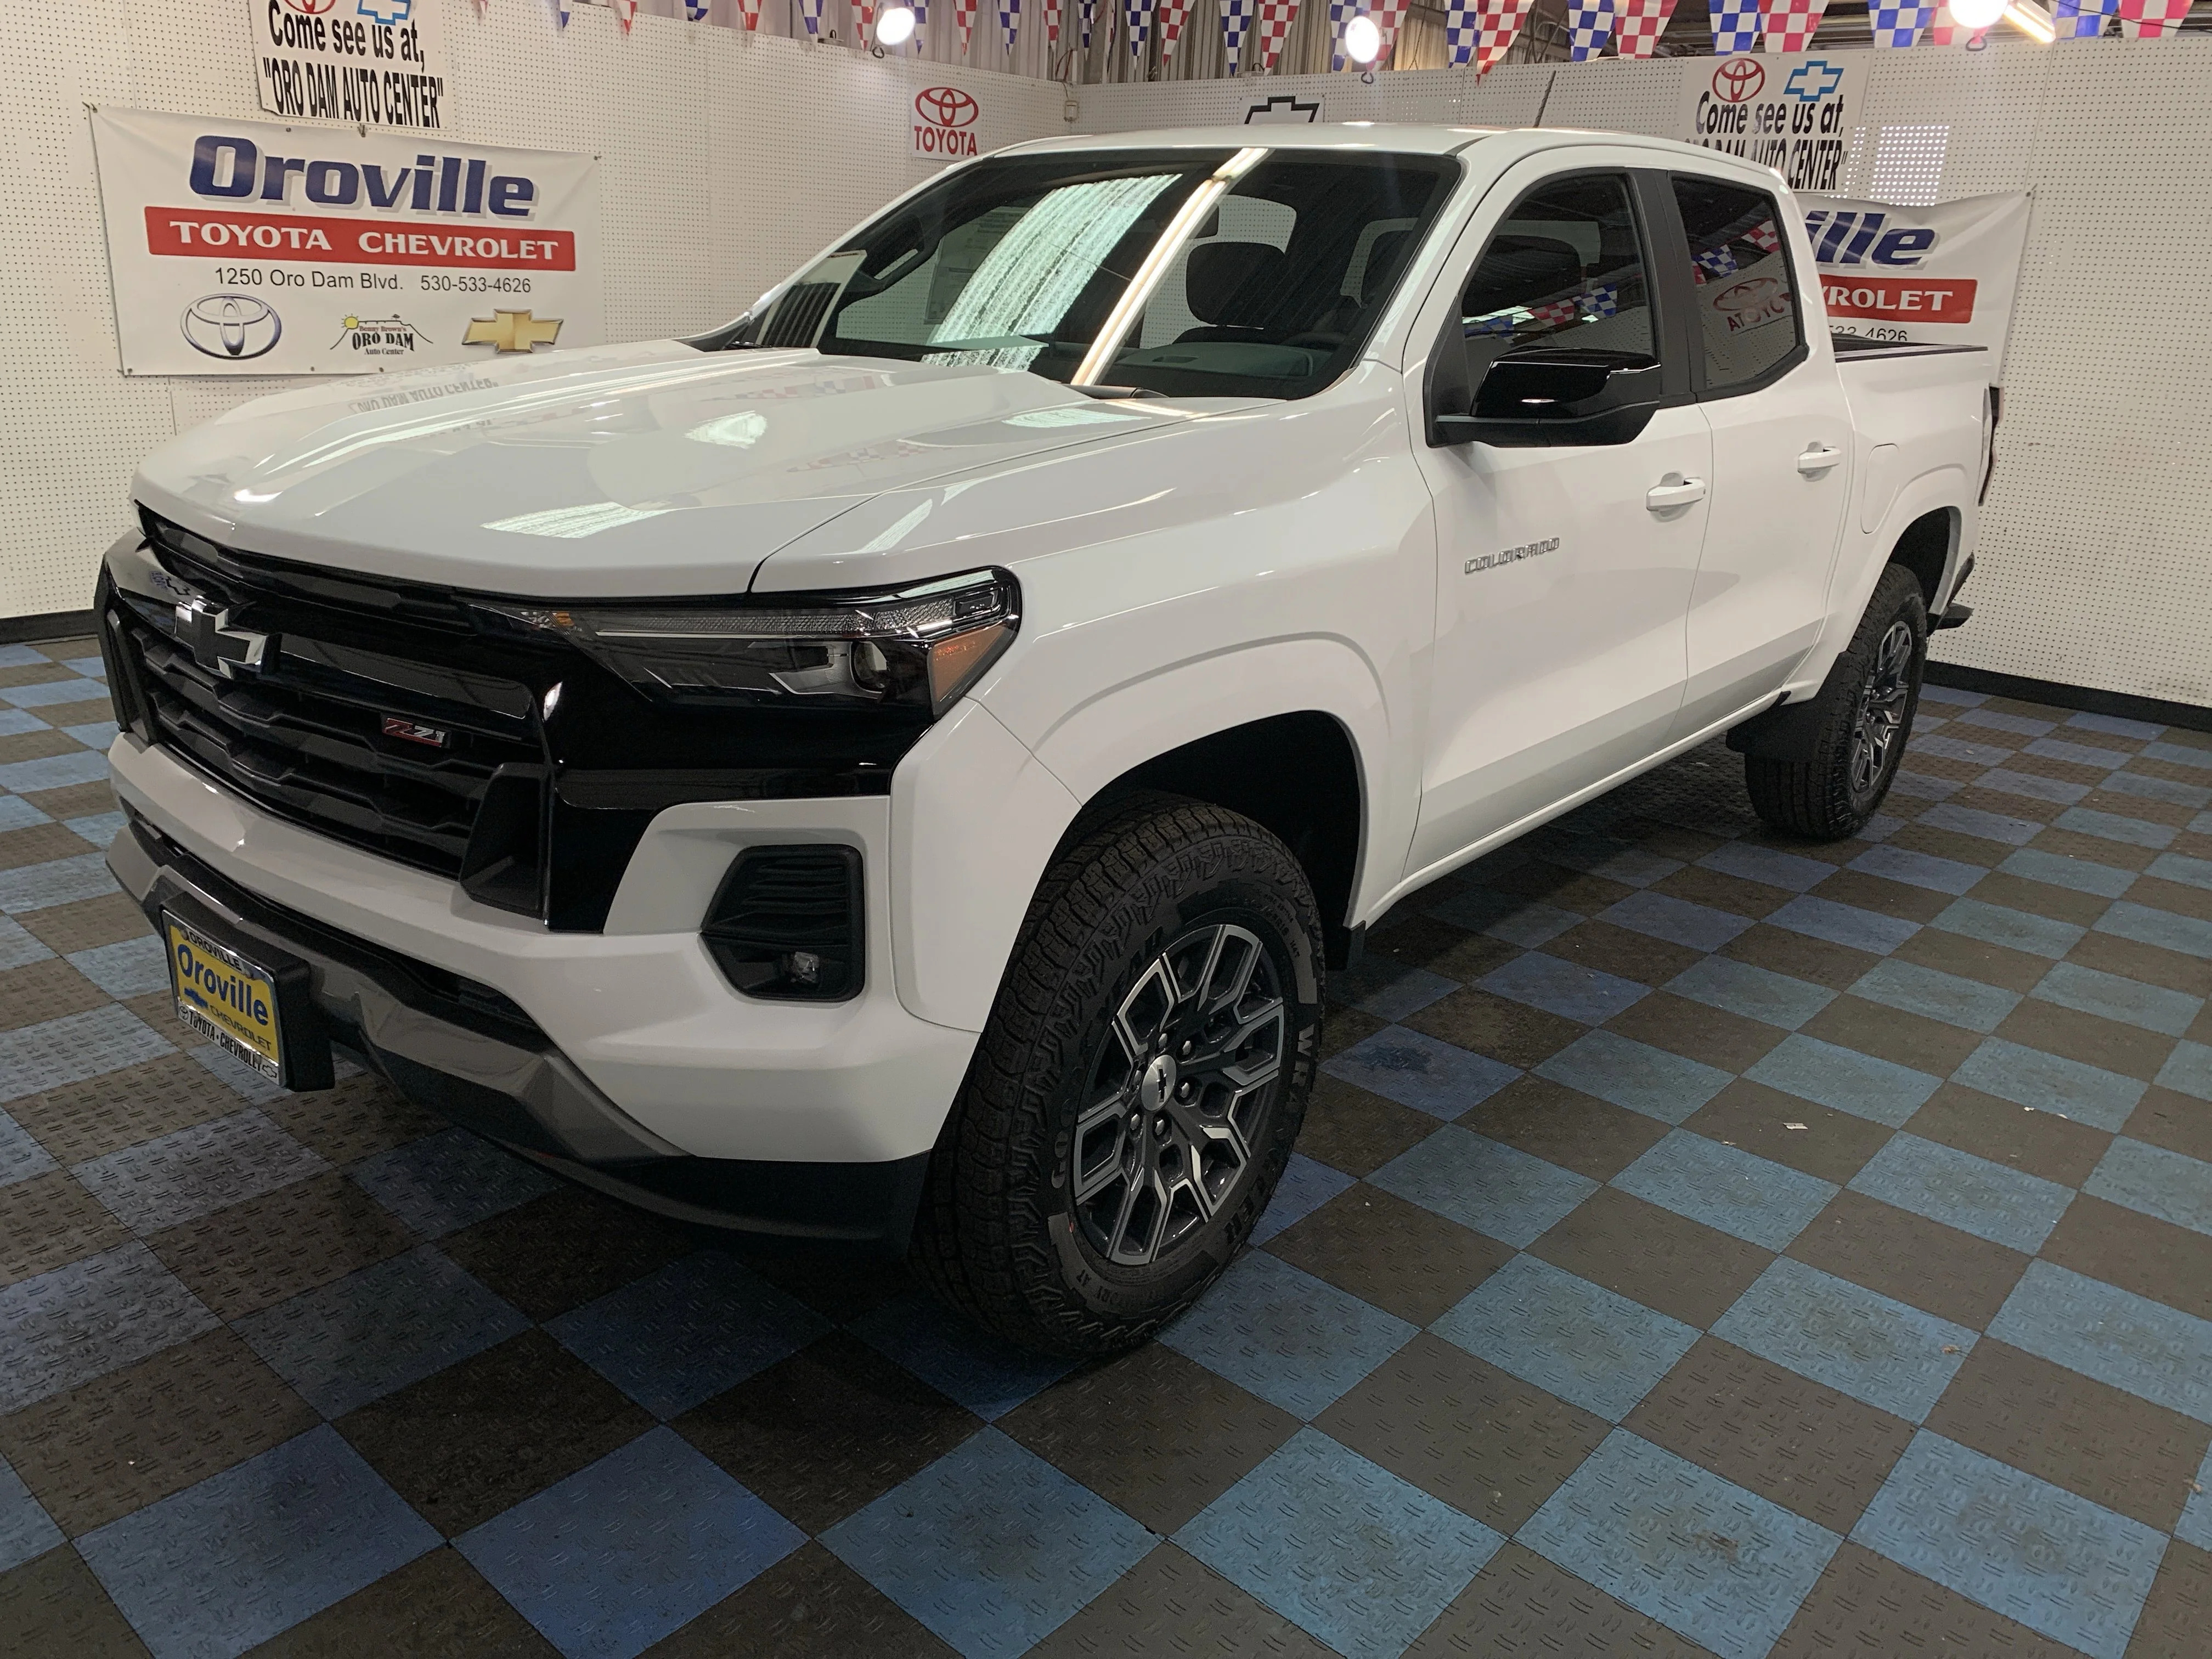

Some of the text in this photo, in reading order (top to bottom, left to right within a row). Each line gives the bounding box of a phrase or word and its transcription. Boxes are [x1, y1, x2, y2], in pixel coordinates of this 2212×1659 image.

[268, 0, 425, 72] Come see us at,
[263, 57, 443, 128] "ORO DAM AUTO CENTER"
[1696, 91, 1844, 137] Come see us at,
[915, 126, 977, 156] TOYOTA
[189, 135, 536, 217] Oroville
[170, 221, 558, 260] TOYOTA CHEVROLET
[215, 268, 531, 294] 1250 Oro Dam Blvd. 530-533-4626
[352, 332, 415, 352] ORO DAM
[1465, 538, 1560, 575] COLORADO
[382, 718, 447, 747] Z71
[189, 932, 242, 971] OROVILLE
[177, 944, 268, 1026] Oroville
[210, 1005, 271, 1051] CHEVROLET
